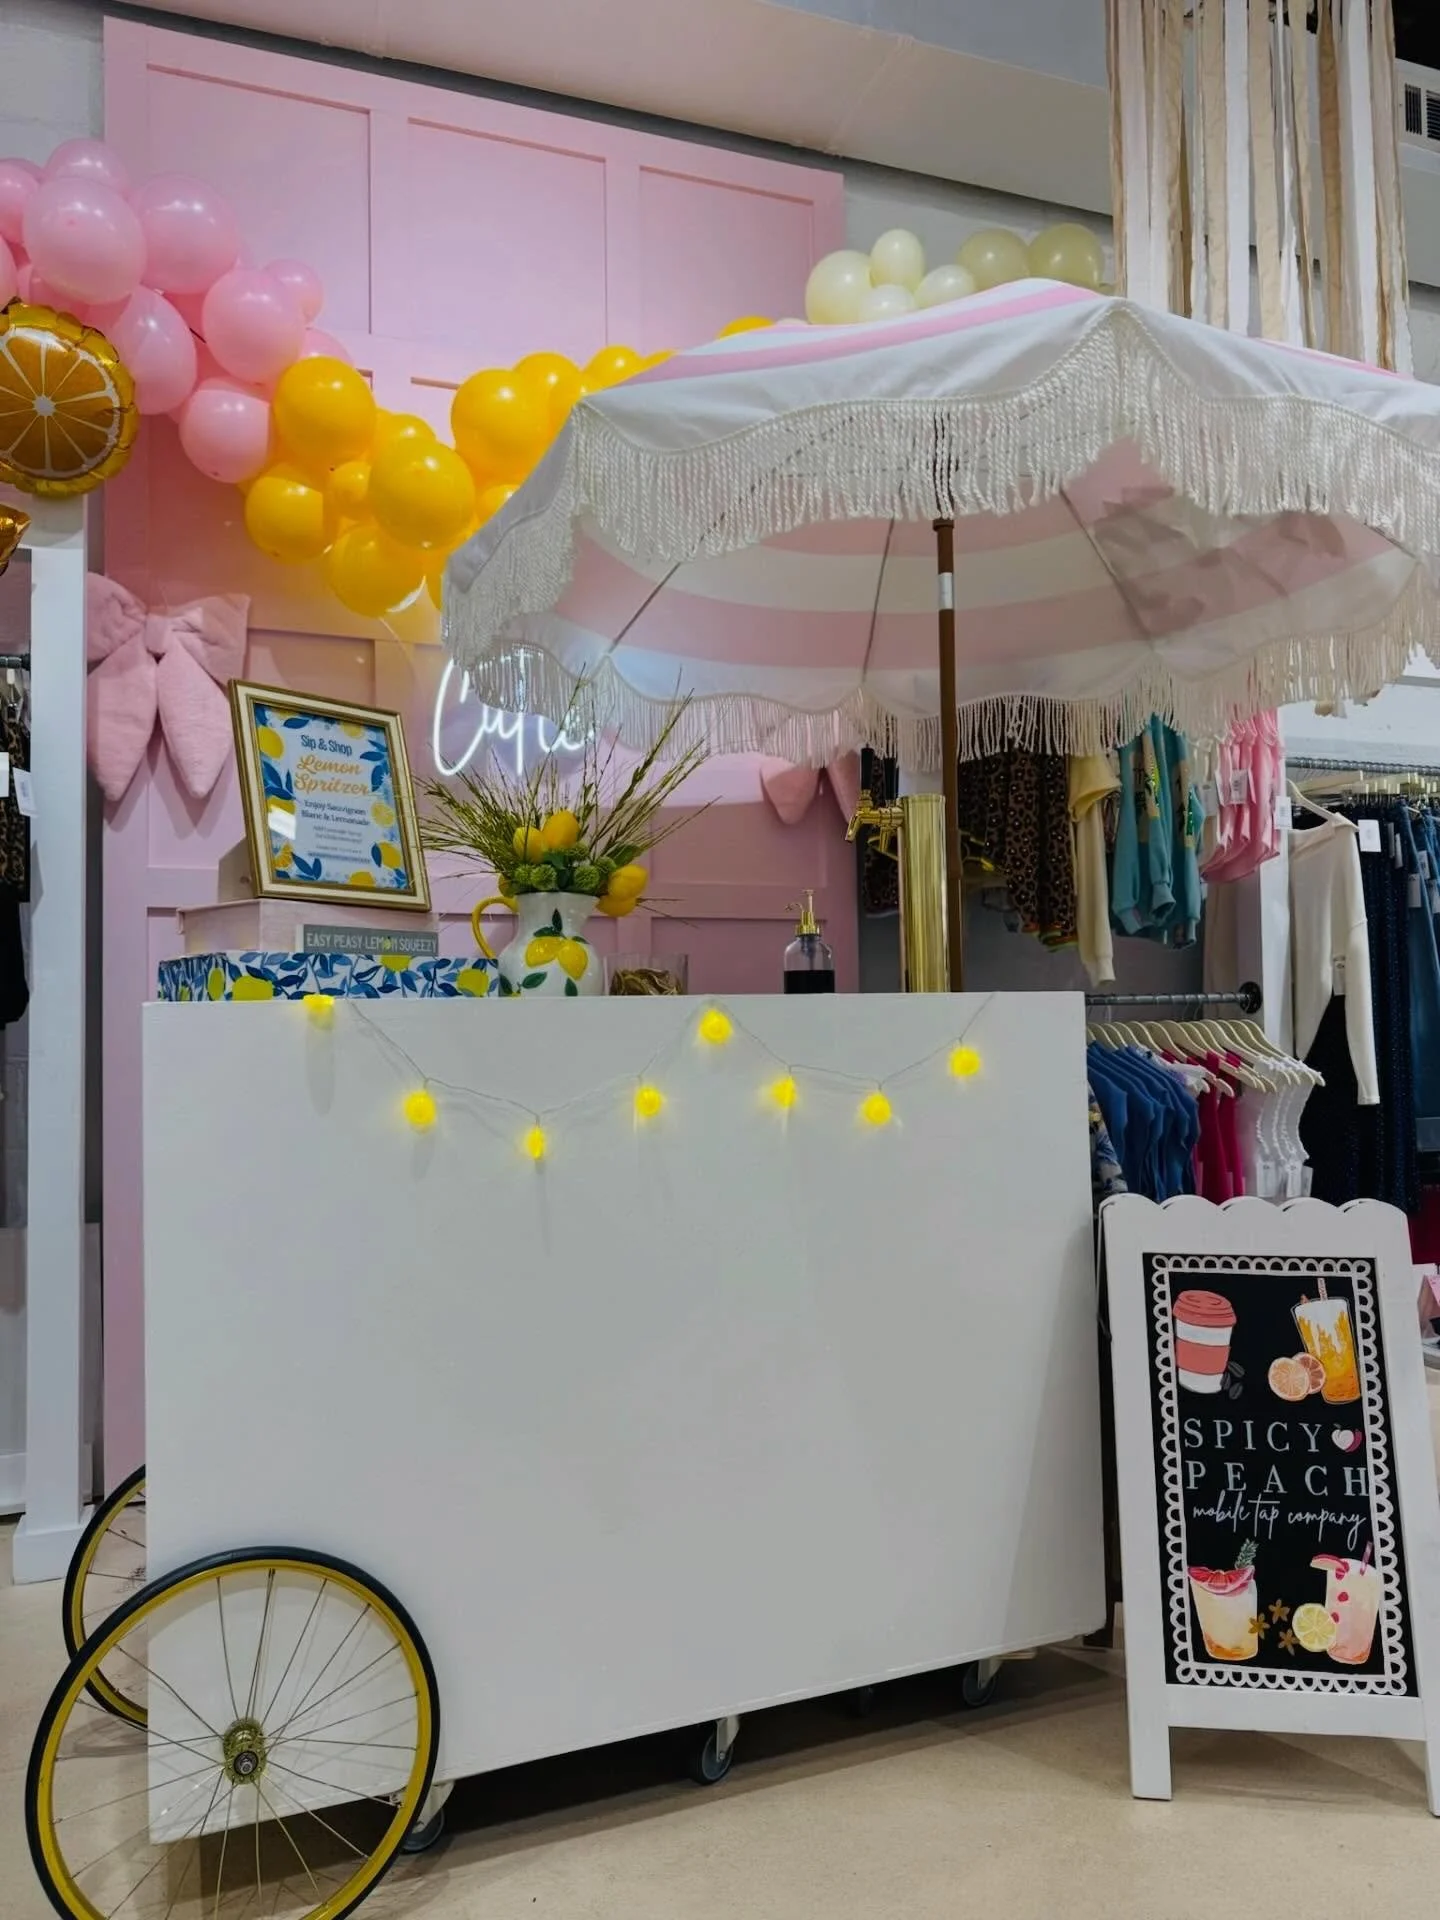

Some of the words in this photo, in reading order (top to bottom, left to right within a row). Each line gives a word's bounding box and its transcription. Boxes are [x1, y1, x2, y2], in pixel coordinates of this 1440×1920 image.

[301, 734, 316, 751] Sip
[318, 738, 328, 751] &
[328, 739, 353, 757] Shop
[296, 755, 363, 775] Lemon
[294, 772, 369, 796] Spritzer
[306, 932, 332, 949] EASY
[334, 934, 363, 950] PEASY
[399, 937, 437, 953] SQUEEZY
[1183, 1417, 1322, 1453] SPICY
[1185, 1460, 1370, 1497] PEACH
[1193, 1489, 1251, 1533] mobile
[1248, 1493, 1281, 1540] tap
[1287, 1509, 1367, 1552] company
